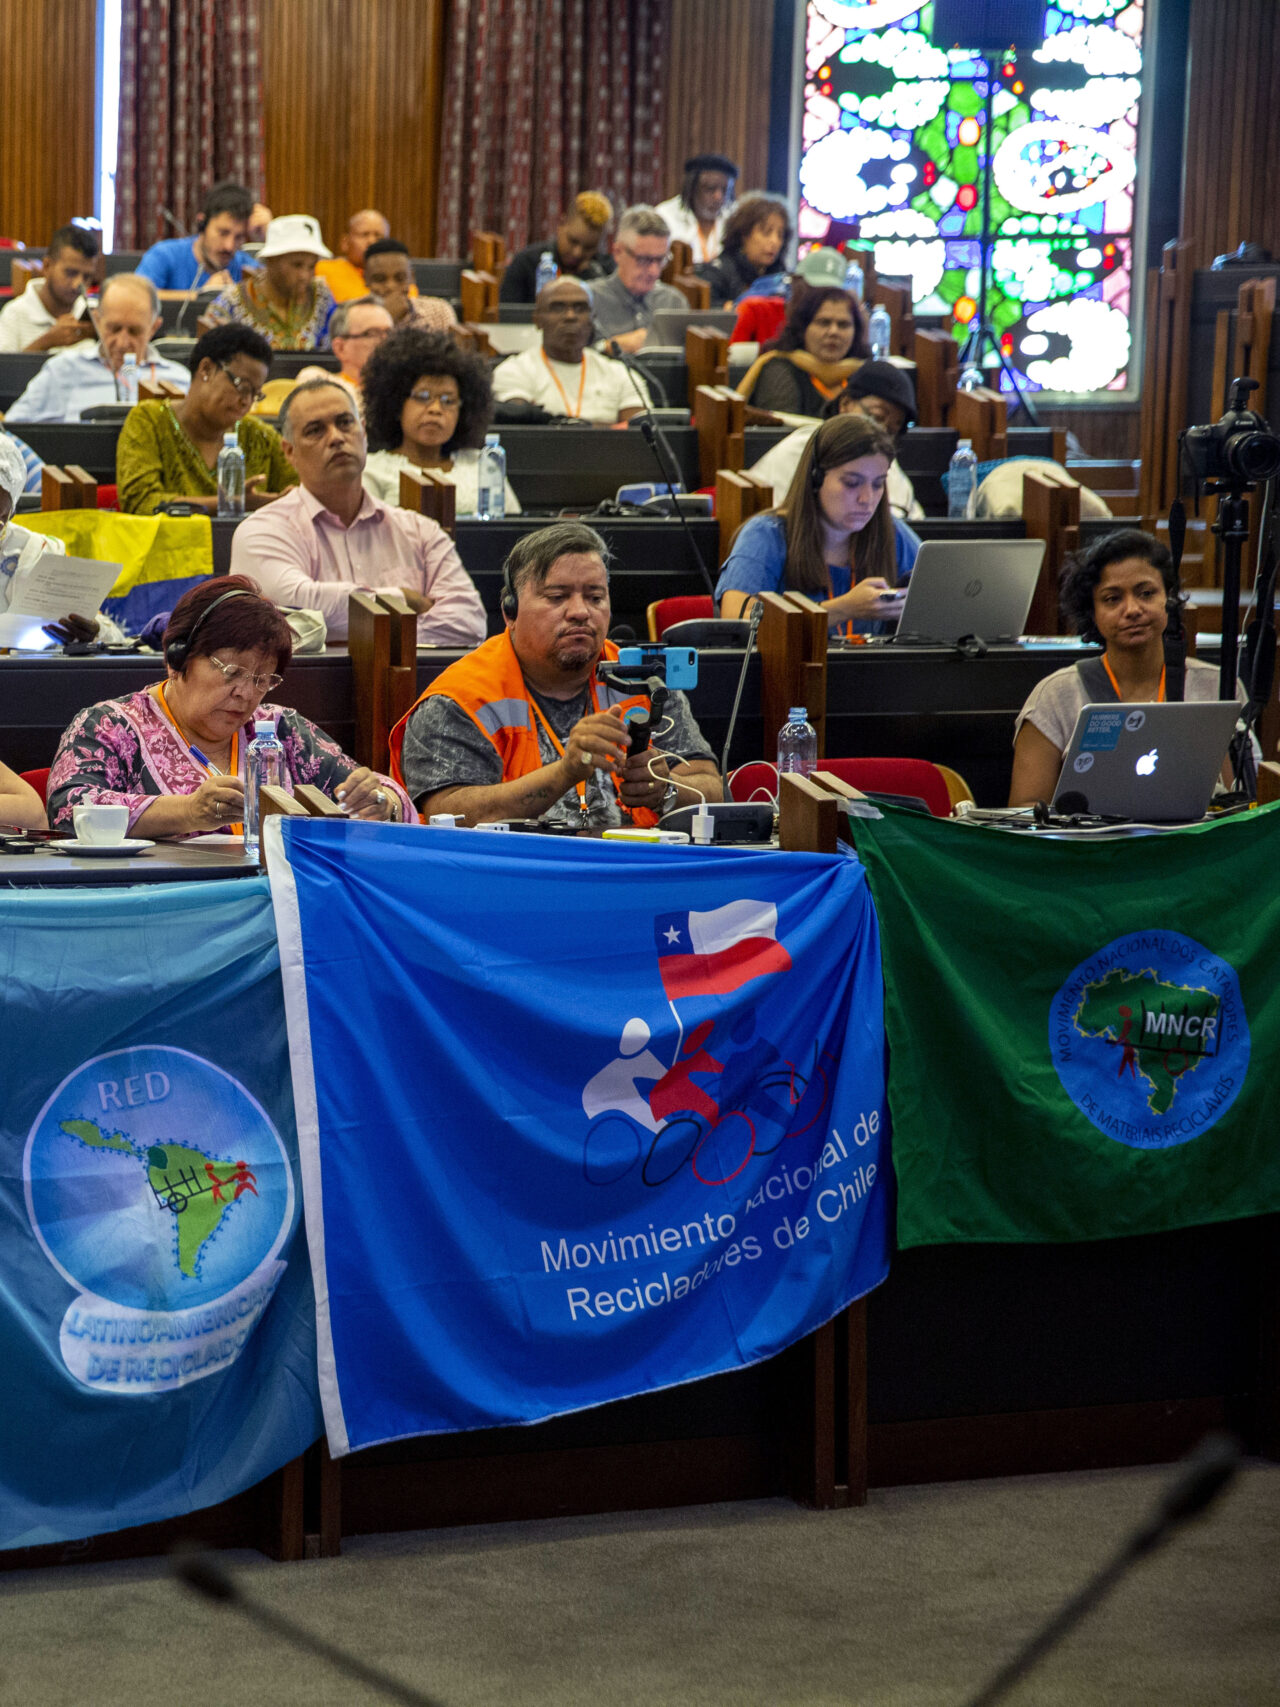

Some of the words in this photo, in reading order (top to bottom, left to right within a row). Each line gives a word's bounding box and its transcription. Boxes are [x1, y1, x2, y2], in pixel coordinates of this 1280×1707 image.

[1097, 936, 1166, 970] NACIONAL
[1170, 938, 1196, 964] DOS
[1198, 957, 1239, 1043] CATADORES
[1145, 1010, 1217, 1039] MNCR
[97, 1071, 171, 1112] RED
[1080, 1092, 1097, 1116] DE
[1097, 1109, 1164, 1143] MATERIAIS
[540, 1212, 736, 1273] Movimiento
[853, 1109, 880, 1147] de
[566, 1236, 763, 1321] Recicladores
[773, 1215, 810, 1251] de
[816, 1163, 878, 1223] Chile
[86, 1355, 121, 1383] DE
